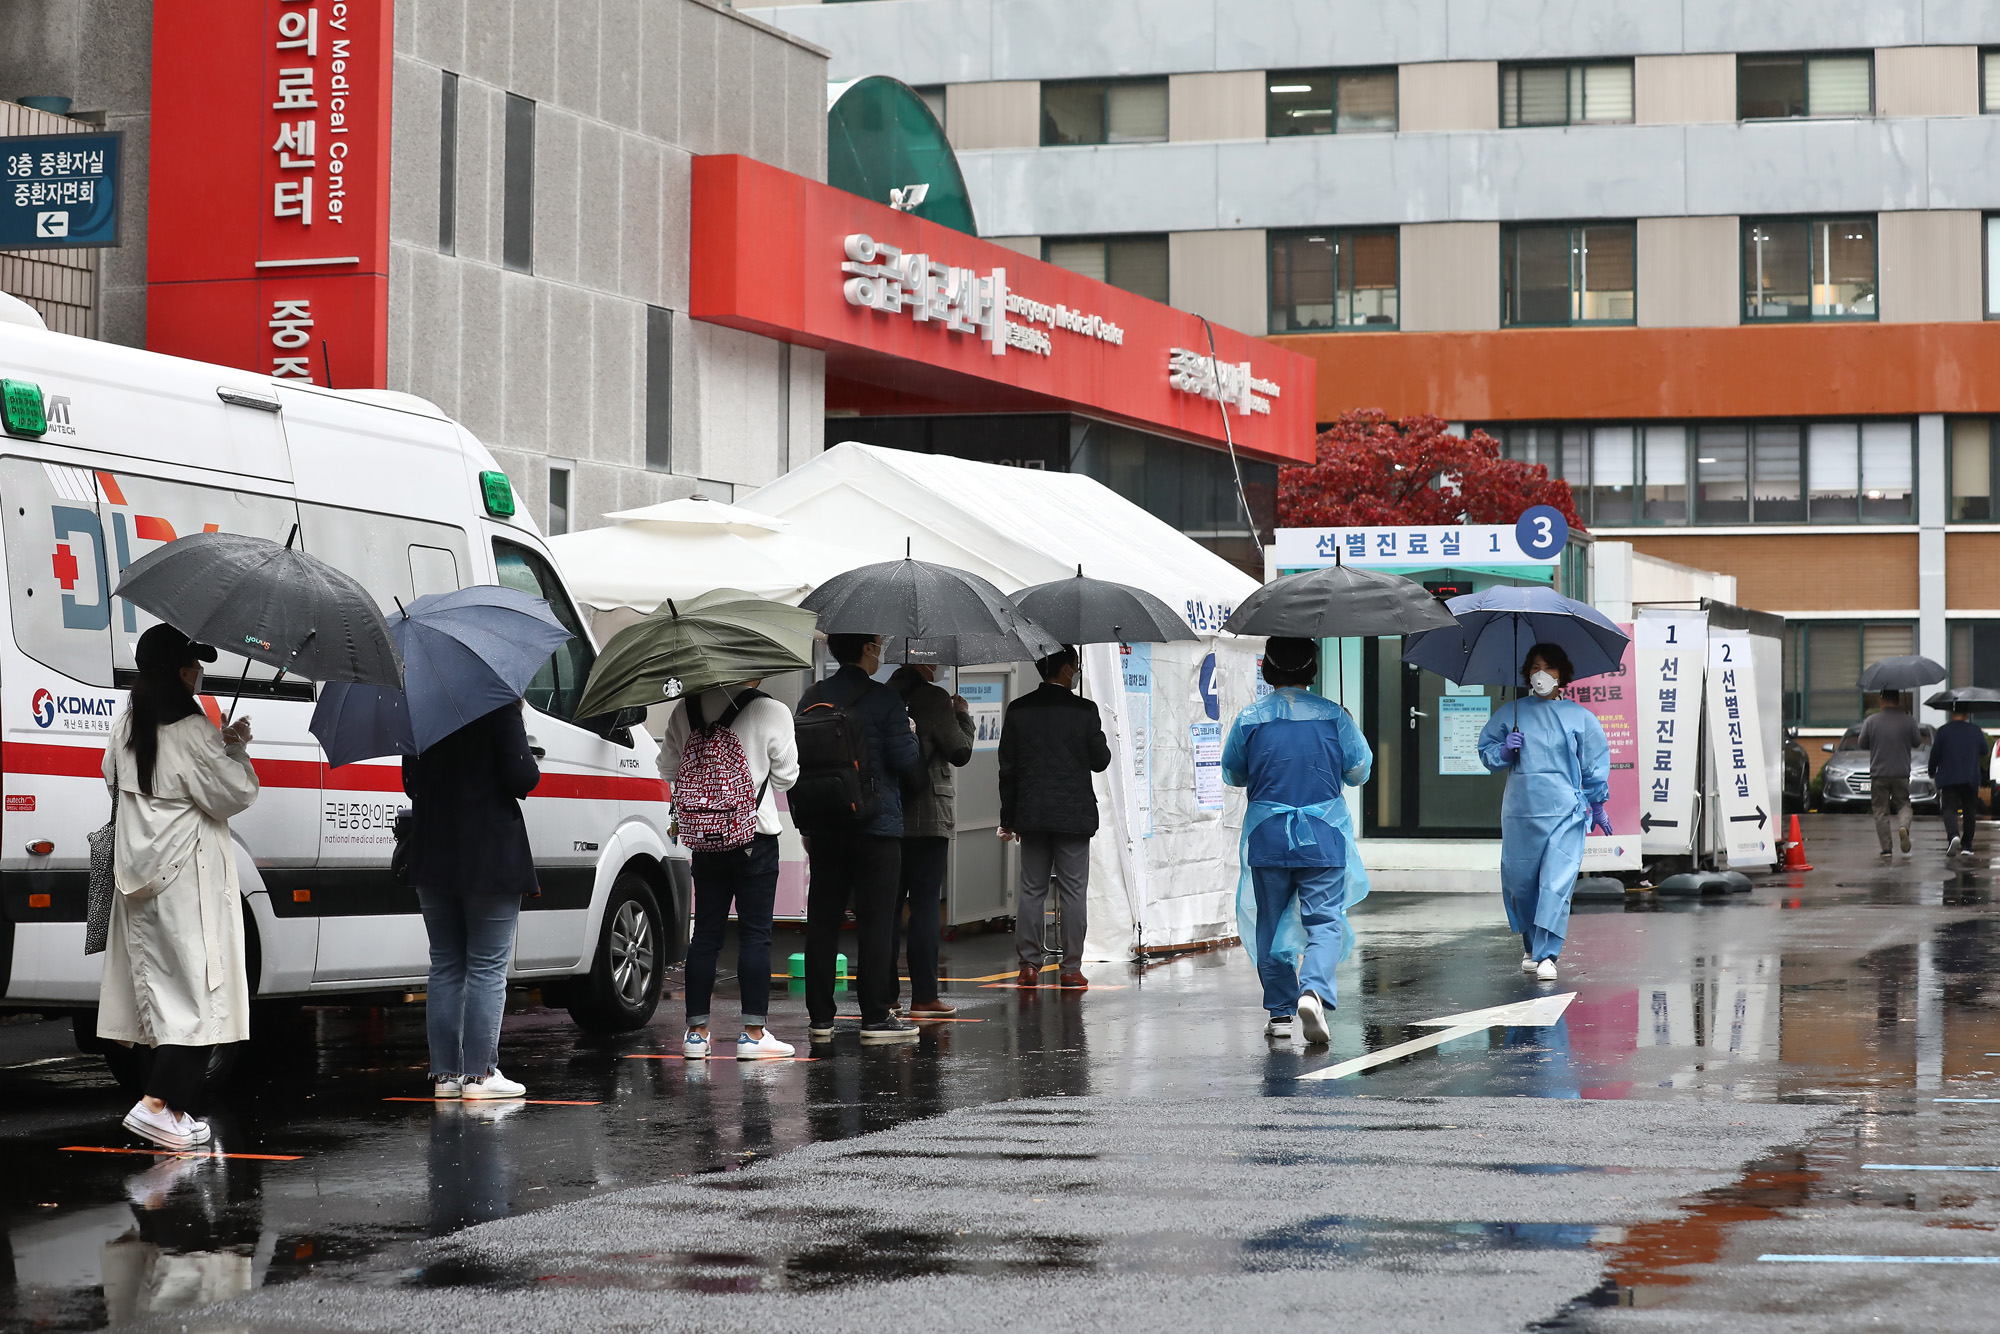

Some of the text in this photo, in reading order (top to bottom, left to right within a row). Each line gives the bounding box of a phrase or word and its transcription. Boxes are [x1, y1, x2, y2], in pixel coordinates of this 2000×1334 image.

[273, 0, 318, 225] 의료센터
[328, 0, 350, 224] cy Medical Center
[7, 150, 104, 177] 3층 중환자실
[14, 180, 94, 207] 중환자면회
[841, 233, 1006, 355] 응급의료센터
[1005, 286, 1124, 345] Emergency Medical Center
[1315, 531, 1501, 558] 선별진료실 1
[1532, 516, 1553, 549] 3
[1665, 625, 1678, 644] 1
[1721, 643, 1733, 663] 2
[57, 696, 116, 717] KDMAT
[1563, 685, 1623, 703] 선별진료
[64, 719, 110, 731] 재난의료지원팀
[1651, 657, 1679, 802] 선별진료실
[1722, 669, 1750, 798] 선별진료실
[325, 834, 350, 844] national
[351, 835, 375, 844] medical
